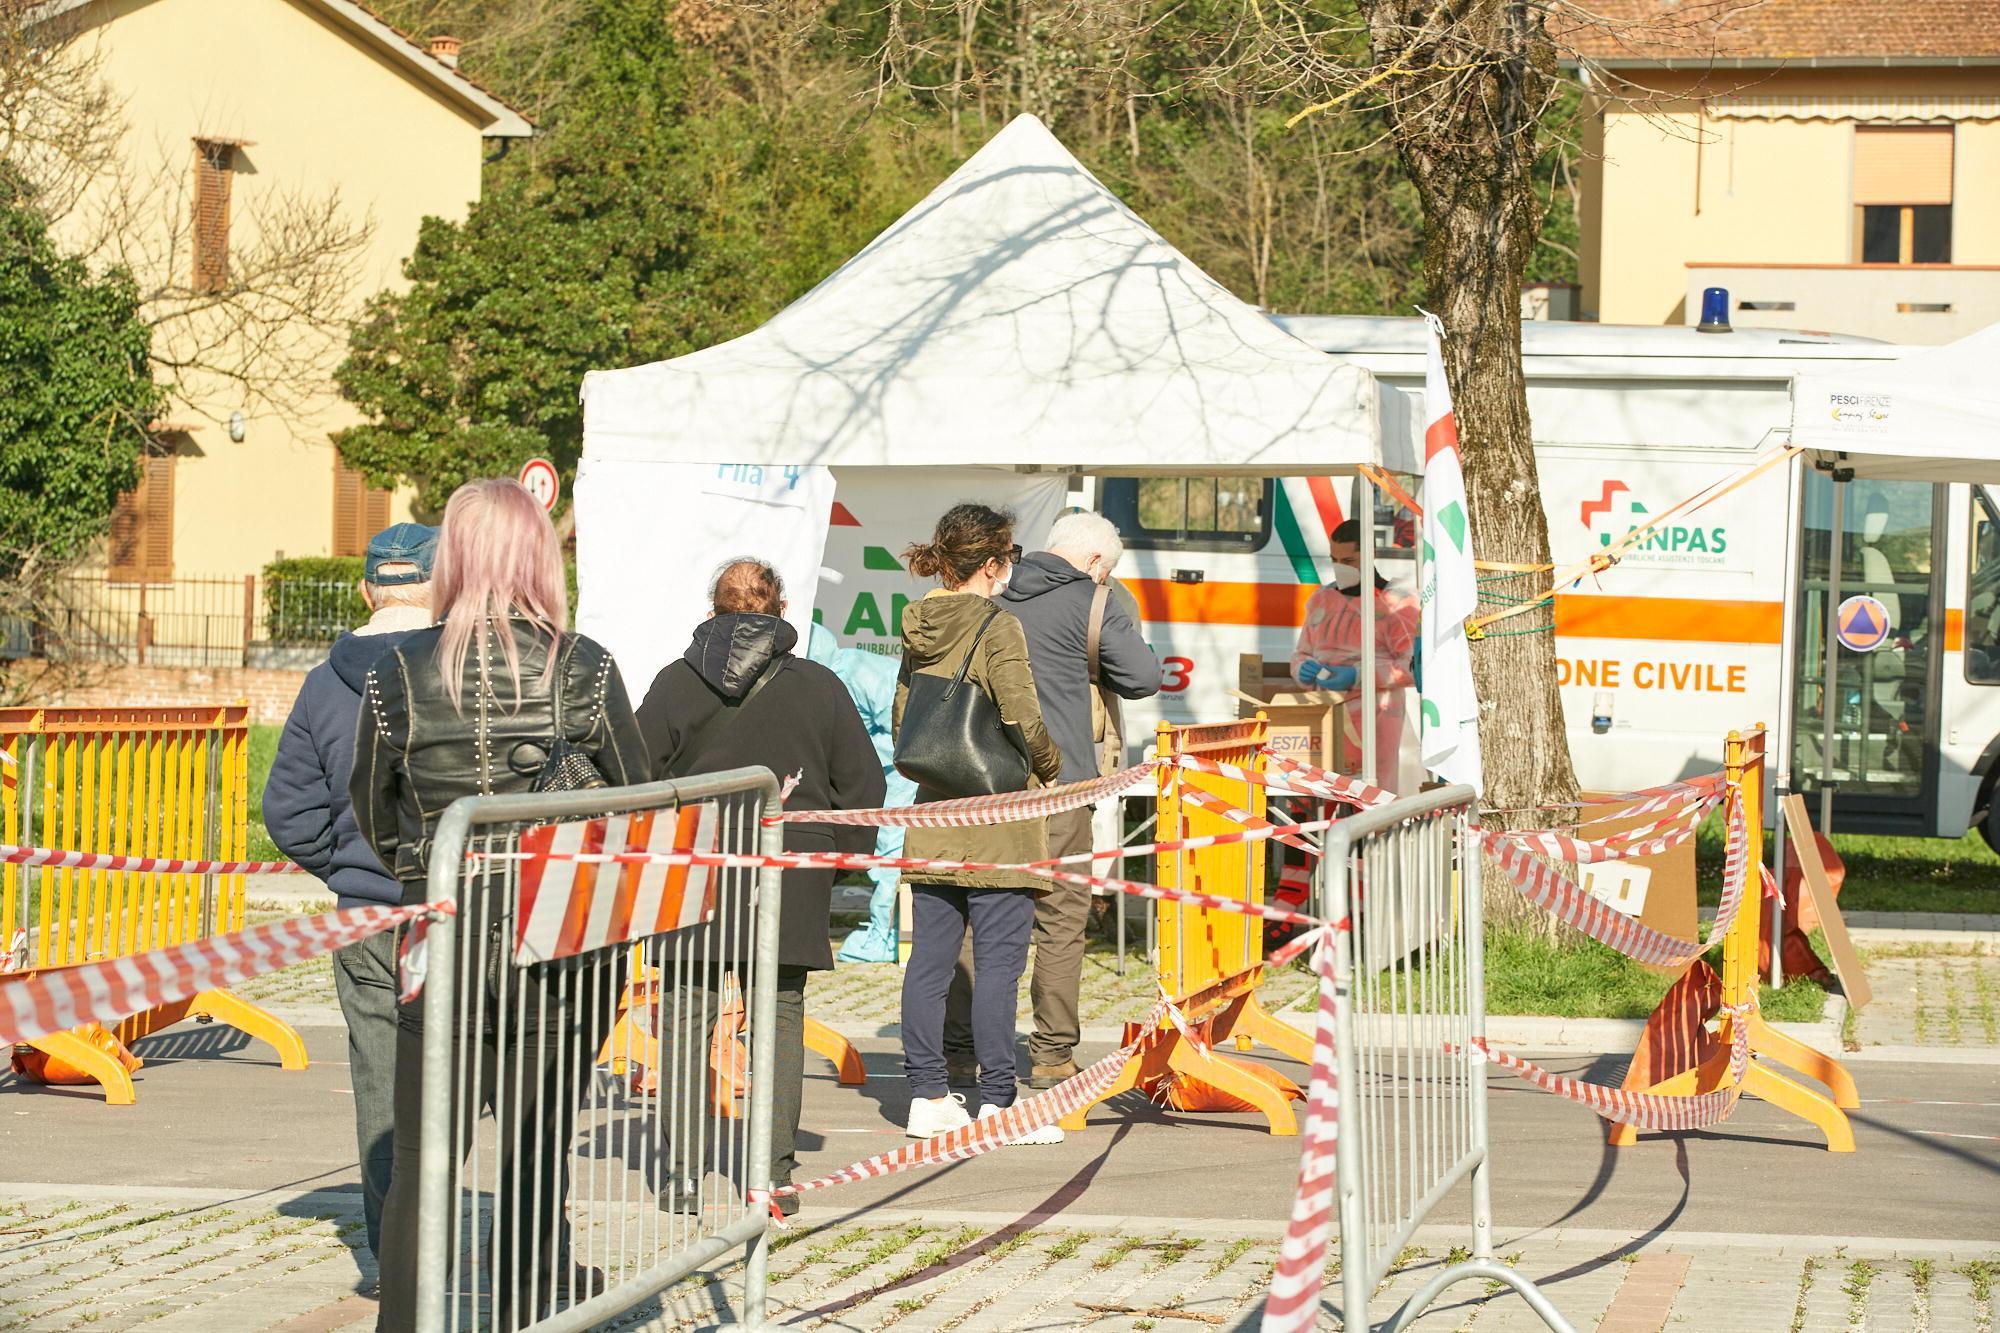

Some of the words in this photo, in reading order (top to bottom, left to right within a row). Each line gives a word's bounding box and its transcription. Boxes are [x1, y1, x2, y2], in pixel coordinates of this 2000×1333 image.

[783, 464, 799, 490] 4
[1633, 661, 1746, 692] CIVILE
[1271, 735, 1322, 751] ESTAR
